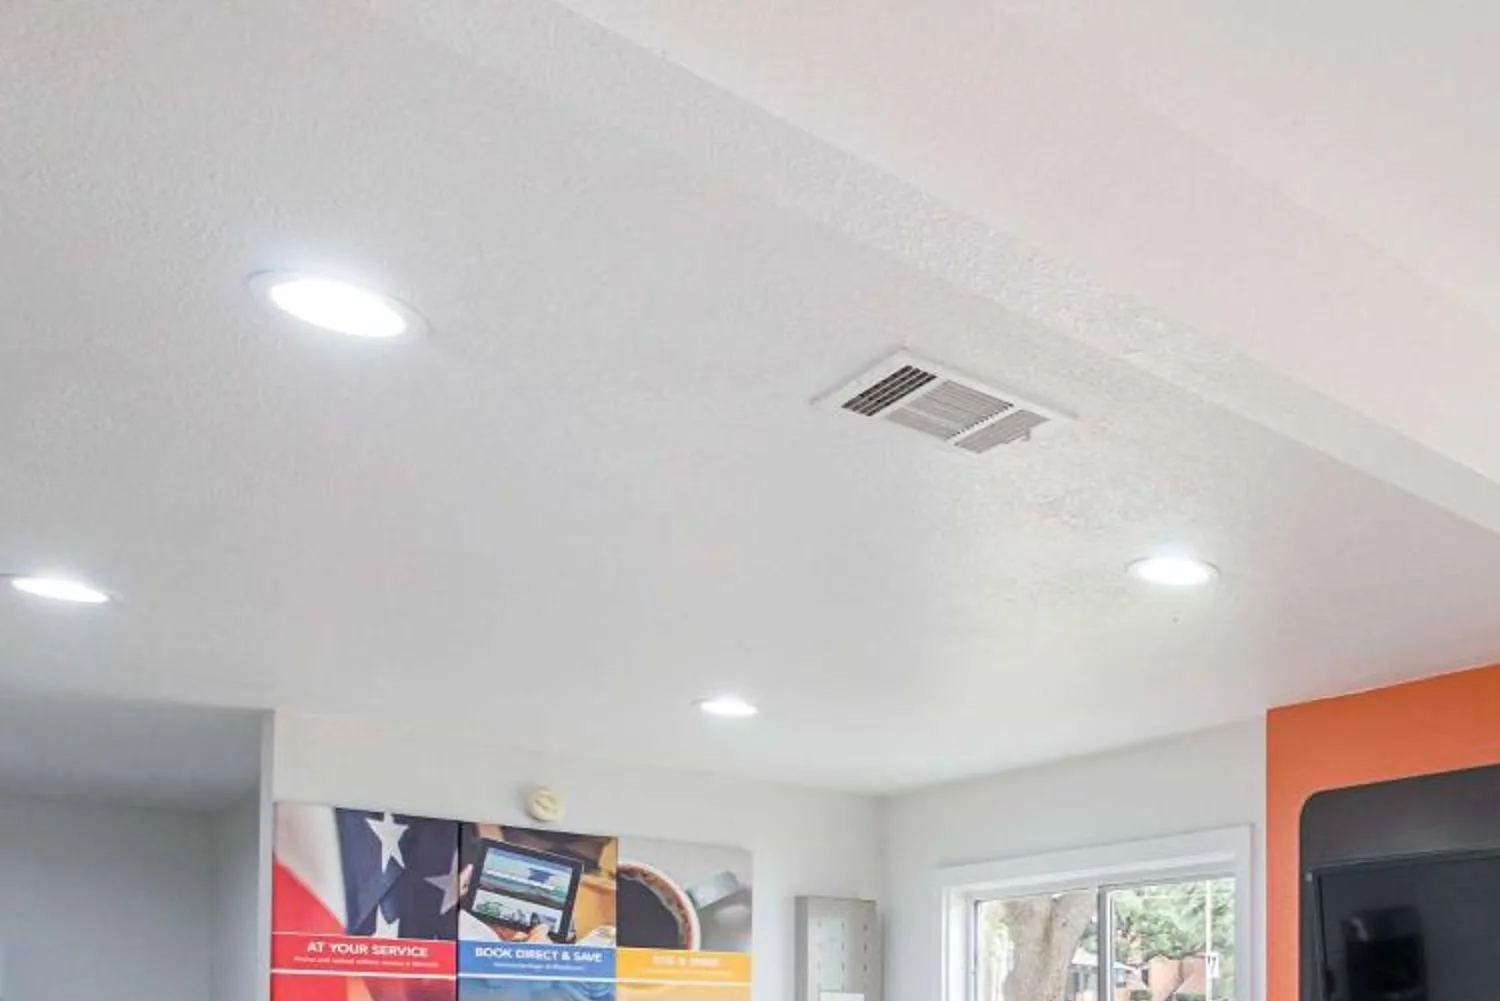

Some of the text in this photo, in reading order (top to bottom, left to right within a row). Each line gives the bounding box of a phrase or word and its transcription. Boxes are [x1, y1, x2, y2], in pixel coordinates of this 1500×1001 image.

[307, 941, 429, 957] AT YOUR SERVICE
[475, 947, 603, 963] BOOK DIRECT & SAVE
